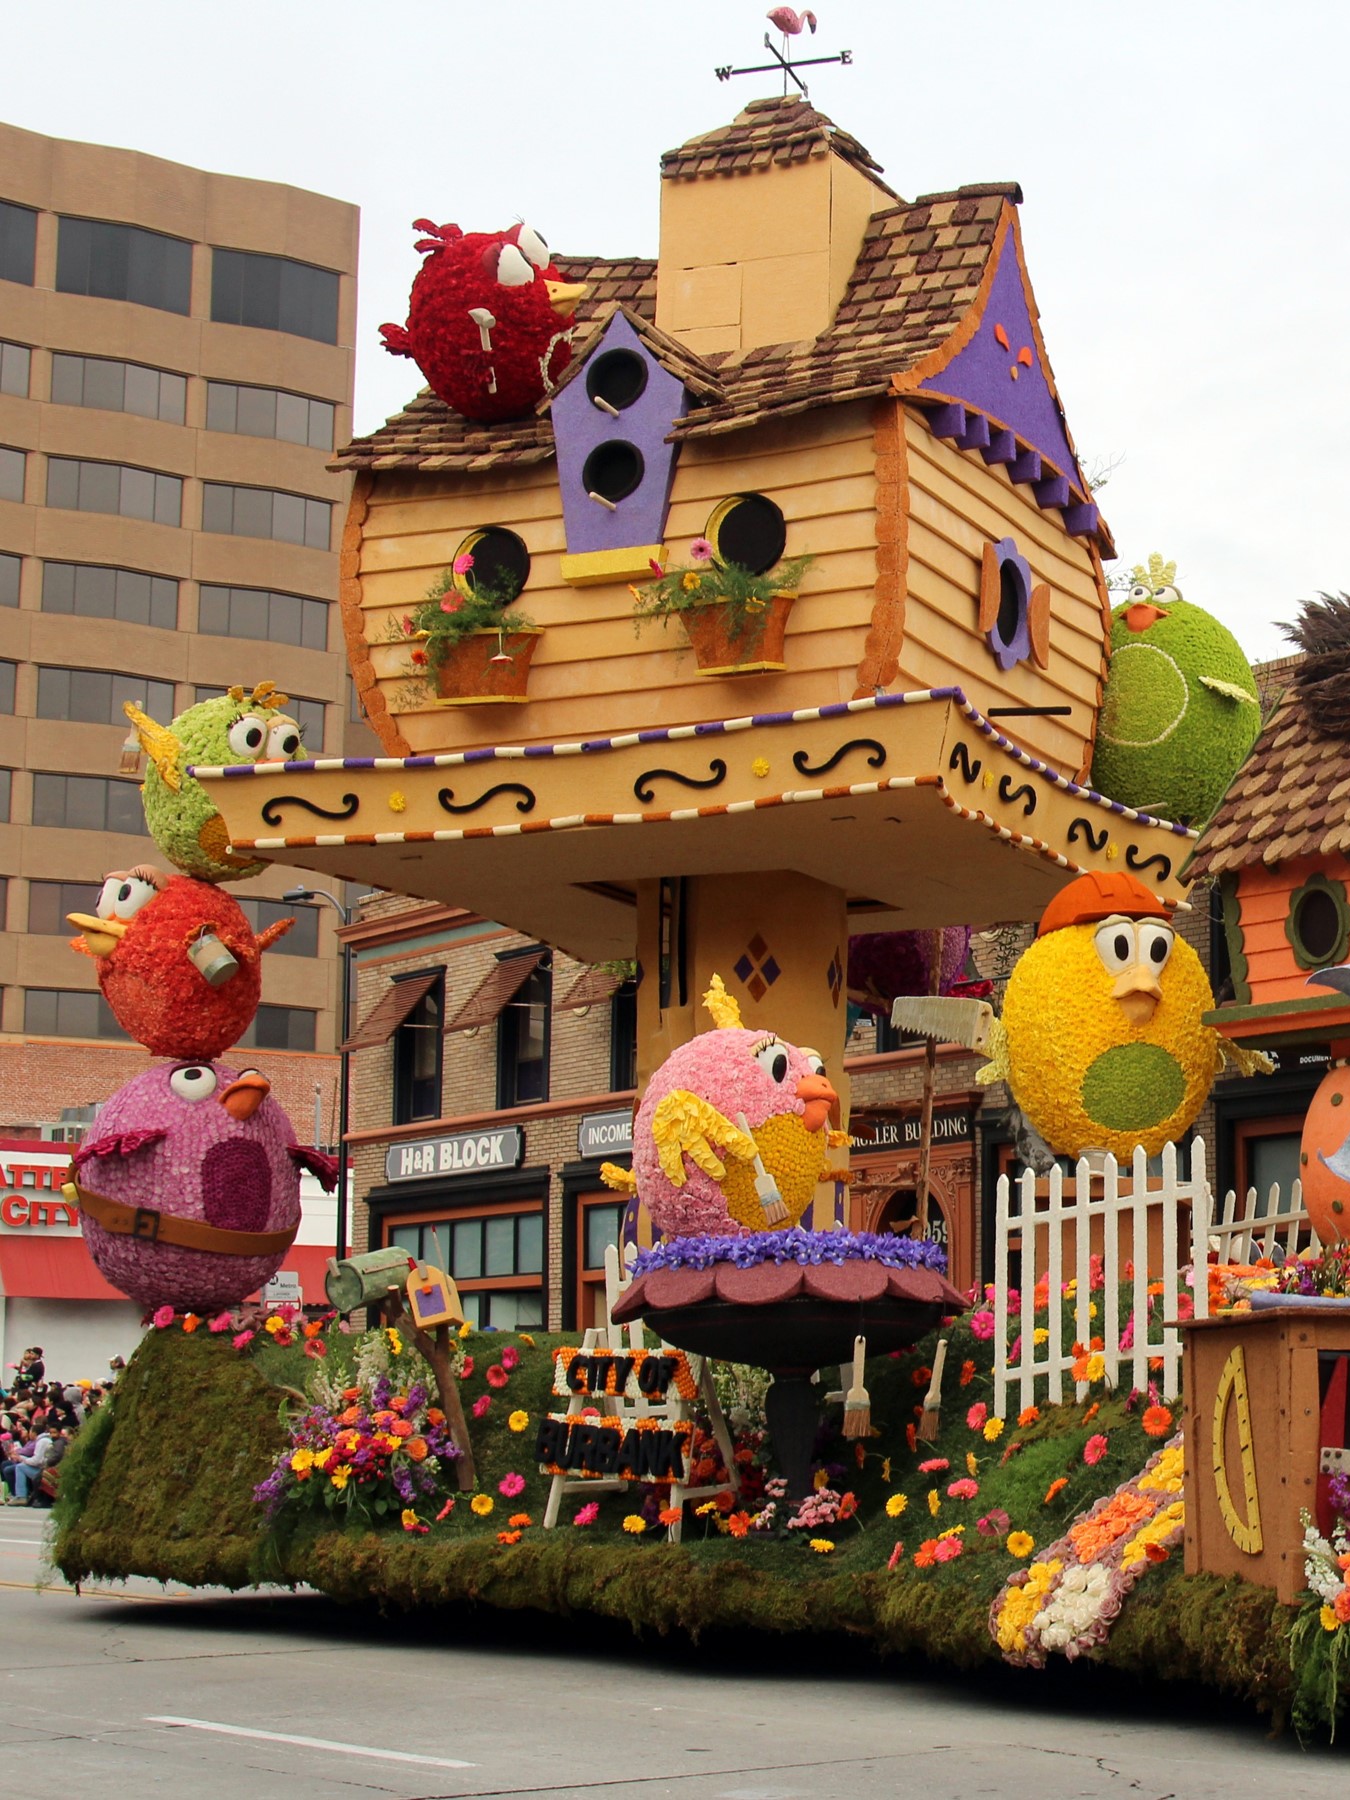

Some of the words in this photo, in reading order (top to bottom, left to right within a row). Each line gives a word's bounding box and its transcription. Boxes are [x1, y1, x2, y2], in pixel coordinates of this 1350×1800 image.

[840, 50, 853, 65] E
[714, 65, 733, 82] W
[1300, 1055, 1331, 1064] DOCUMEN
[589, 1122, 632, 1145] INCOME
[851, 1125, 899, 1148] LER
[905, 1117, 967, 1142] BUDING
[401, 1142, 435, 1175] H&R
[439, 1135, 504, 1170] BLOCK
[2, 1194, 79, 1228] CITY
[566, 1354, 635, 1394] CITY
[638, 1355, 679, 1395] OF
[534, 1418, 688, 1479] BURBANK
